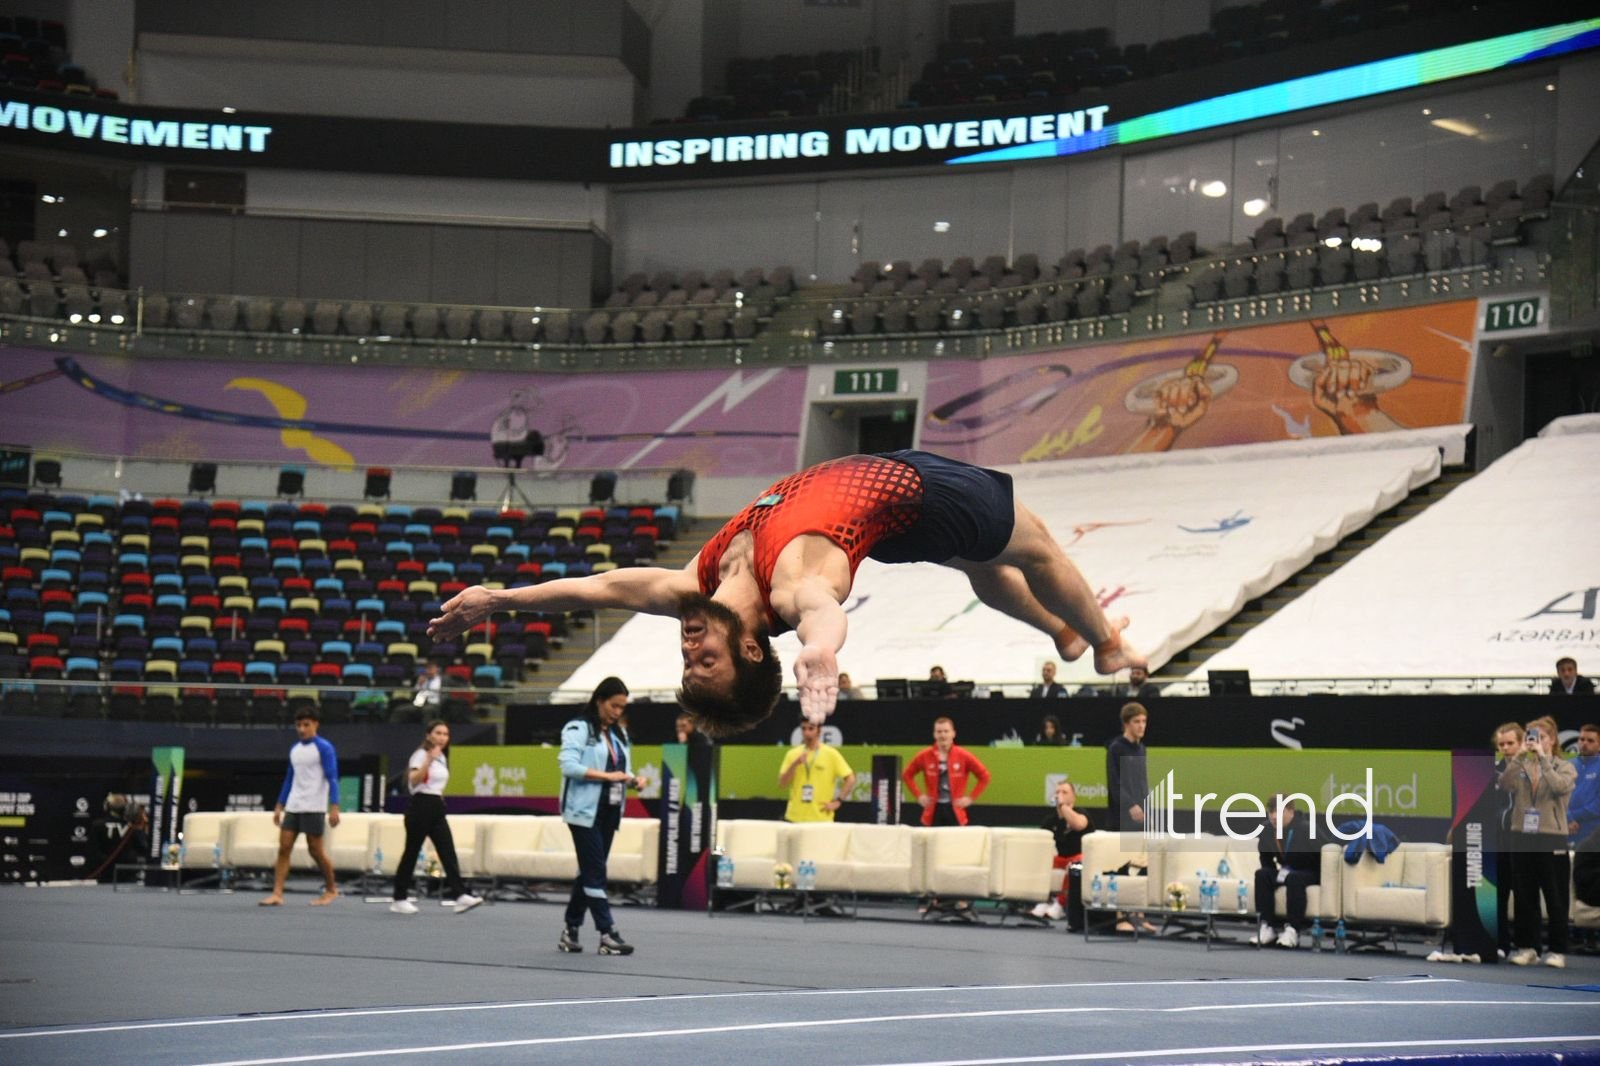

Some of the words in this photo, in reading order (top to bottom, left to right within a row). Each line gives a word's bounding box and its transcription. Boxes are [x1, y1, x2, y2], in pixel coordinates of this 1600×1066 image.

[609, 130, 829, 168] INSPIRING
[845, 105, 1109, 155] MOVEMENT
[1491, 302, 1534, 327] 110
[850, 372, 883, 391] 111
[105, 822, 129, 838] TV
[1466, 822, 1482, 888] TUMBLING
